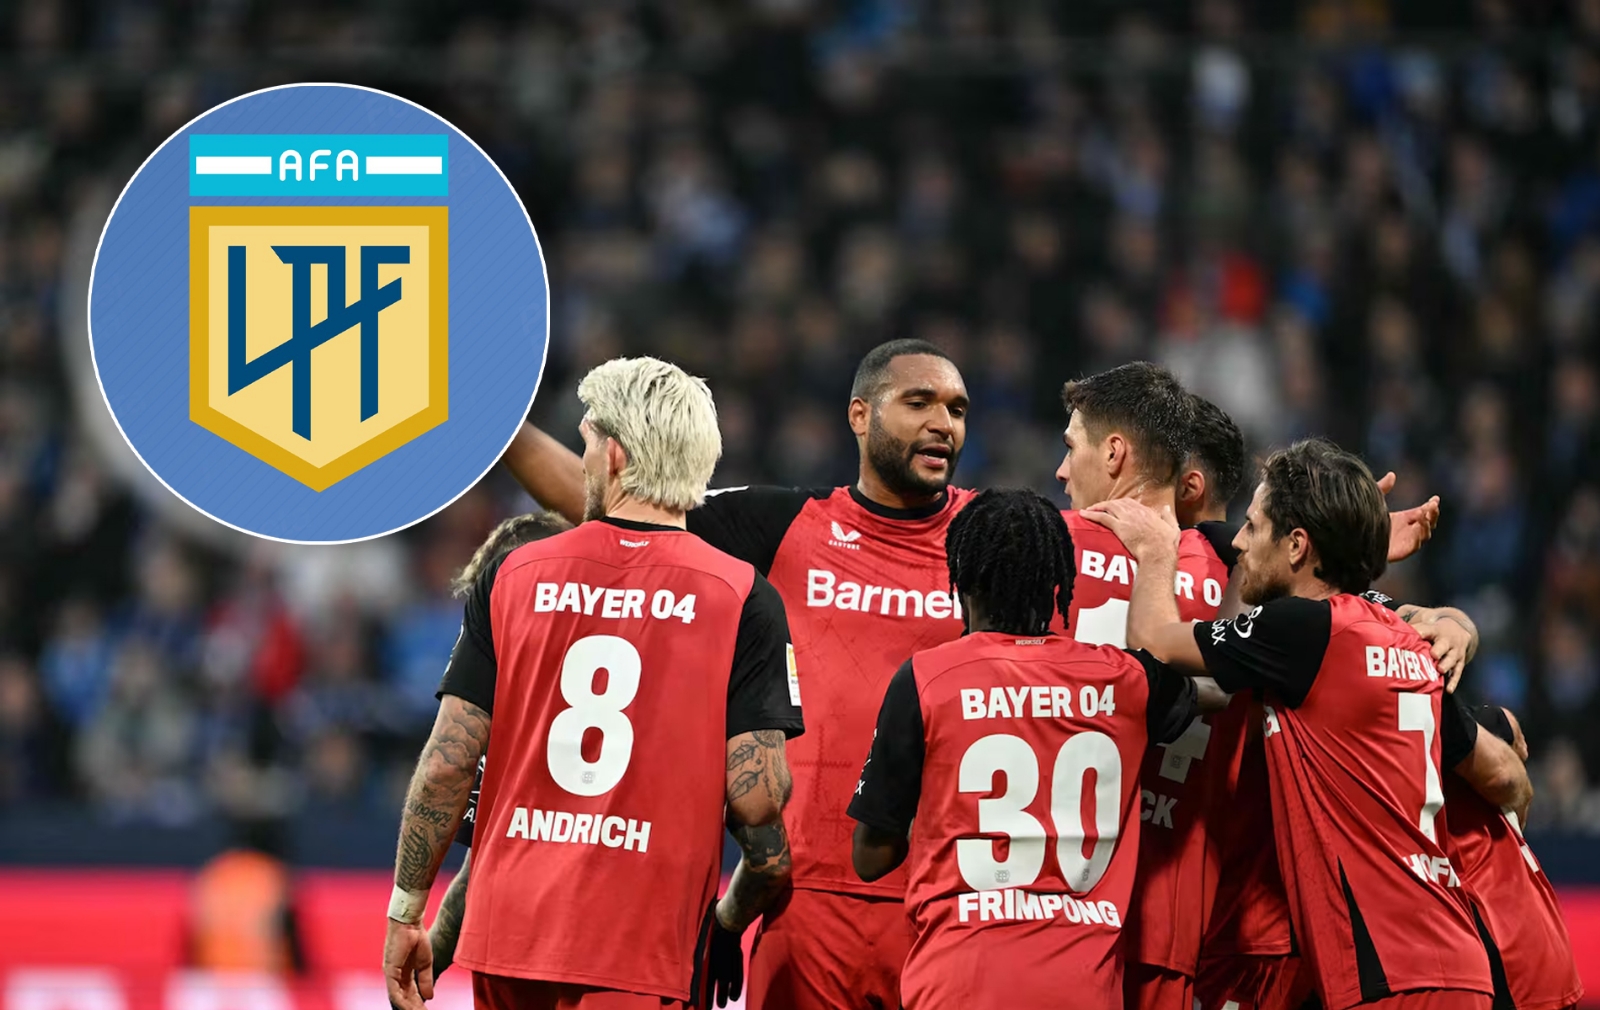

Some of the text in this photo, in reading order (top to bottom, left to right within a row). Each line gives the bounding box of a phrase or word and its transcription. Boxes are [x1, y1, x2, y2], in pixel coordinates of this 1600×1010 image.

[1081, 549, 1194, 600] BAR
[534, 582, 696, 624] BAYER 04
[1365, 645, 1428, 681] BAYER
[546, 635, 642, 797] 8
[960, 684, 1116, 719] BAYER 04
[1398, 691, 1446, 845] 7
[505, 806, 652, 853] ANDRICH
[956, 731, 1123, 893] 30
[957, 890, 1122, 928] FRIMPONG
